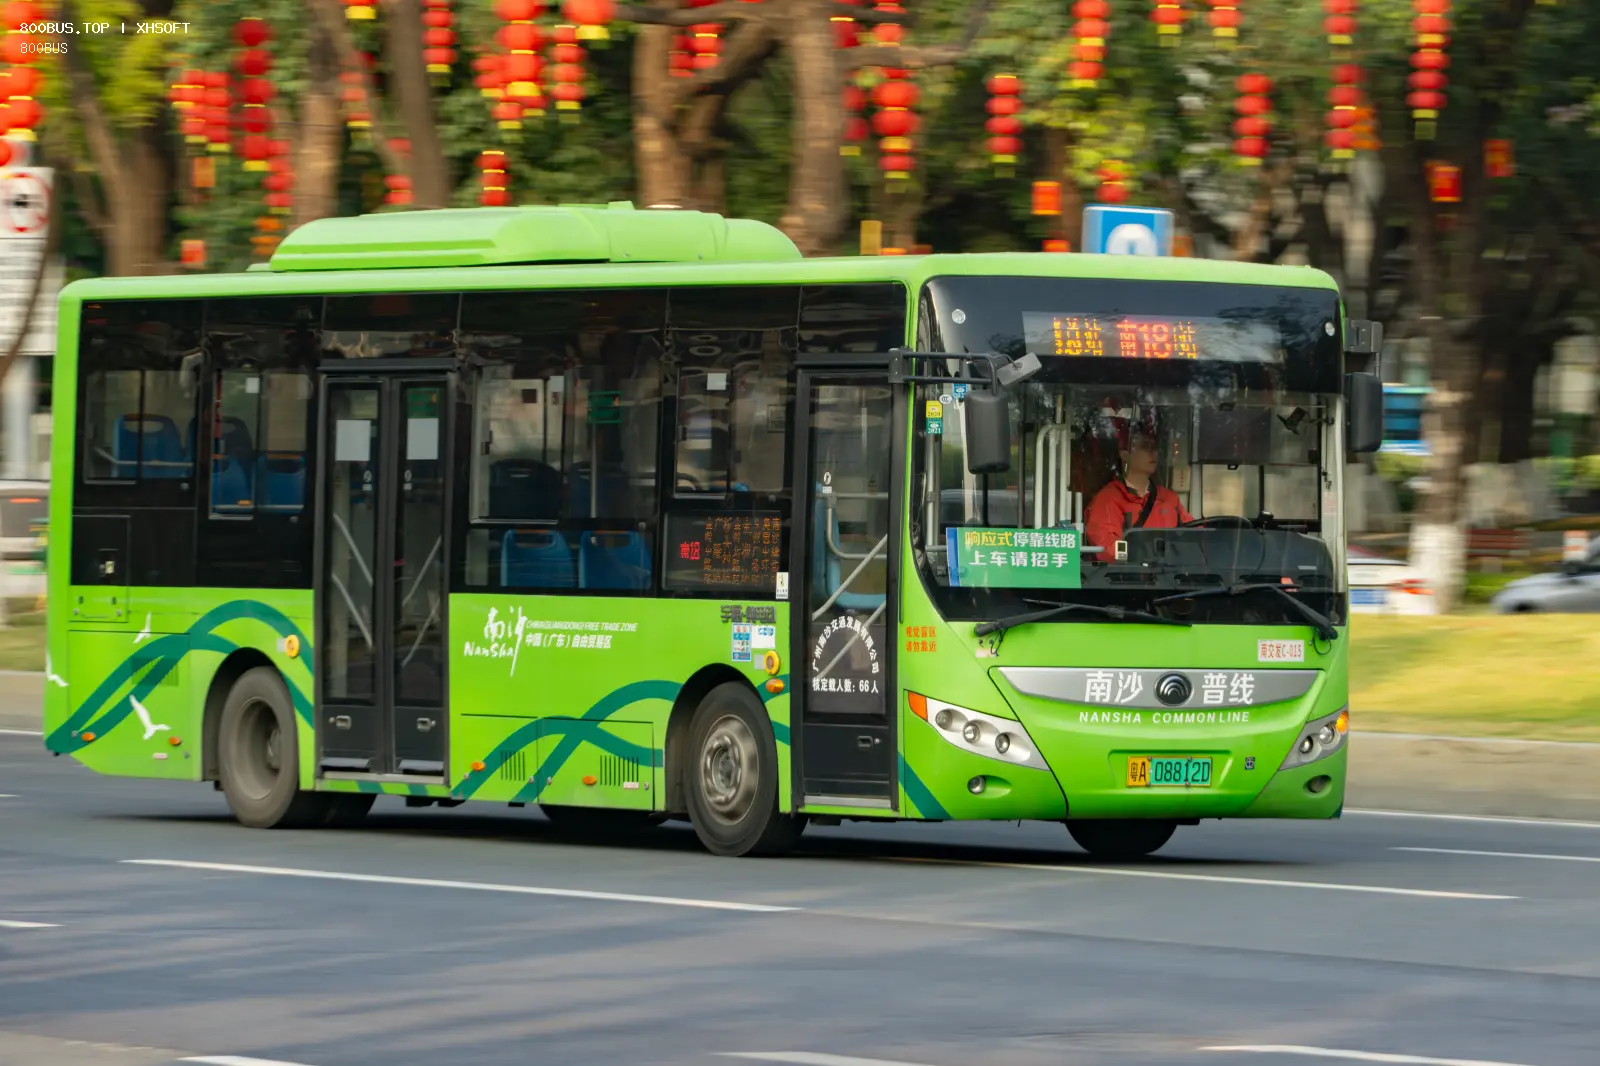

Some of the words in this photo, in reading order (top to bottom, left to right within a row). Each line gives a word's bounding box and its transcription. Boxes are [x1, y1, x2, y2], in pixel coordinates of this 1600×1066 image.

[964, 531, 1077, 549] 响应式停靠线路
[968, 550, 1069, 568] 上车请招手
[600, 622, 619, 632] TRADE
[620, 622, 638, 632] ZONE
[463, 641, 515, 658] NanSha
[1084, 670, 1144, 704] 南沙
[1201, 672, 1255, 705] 普线
[1079, 711, 1142, 724] NANSHA
[1154, 761, 1211, 783] 08812D
